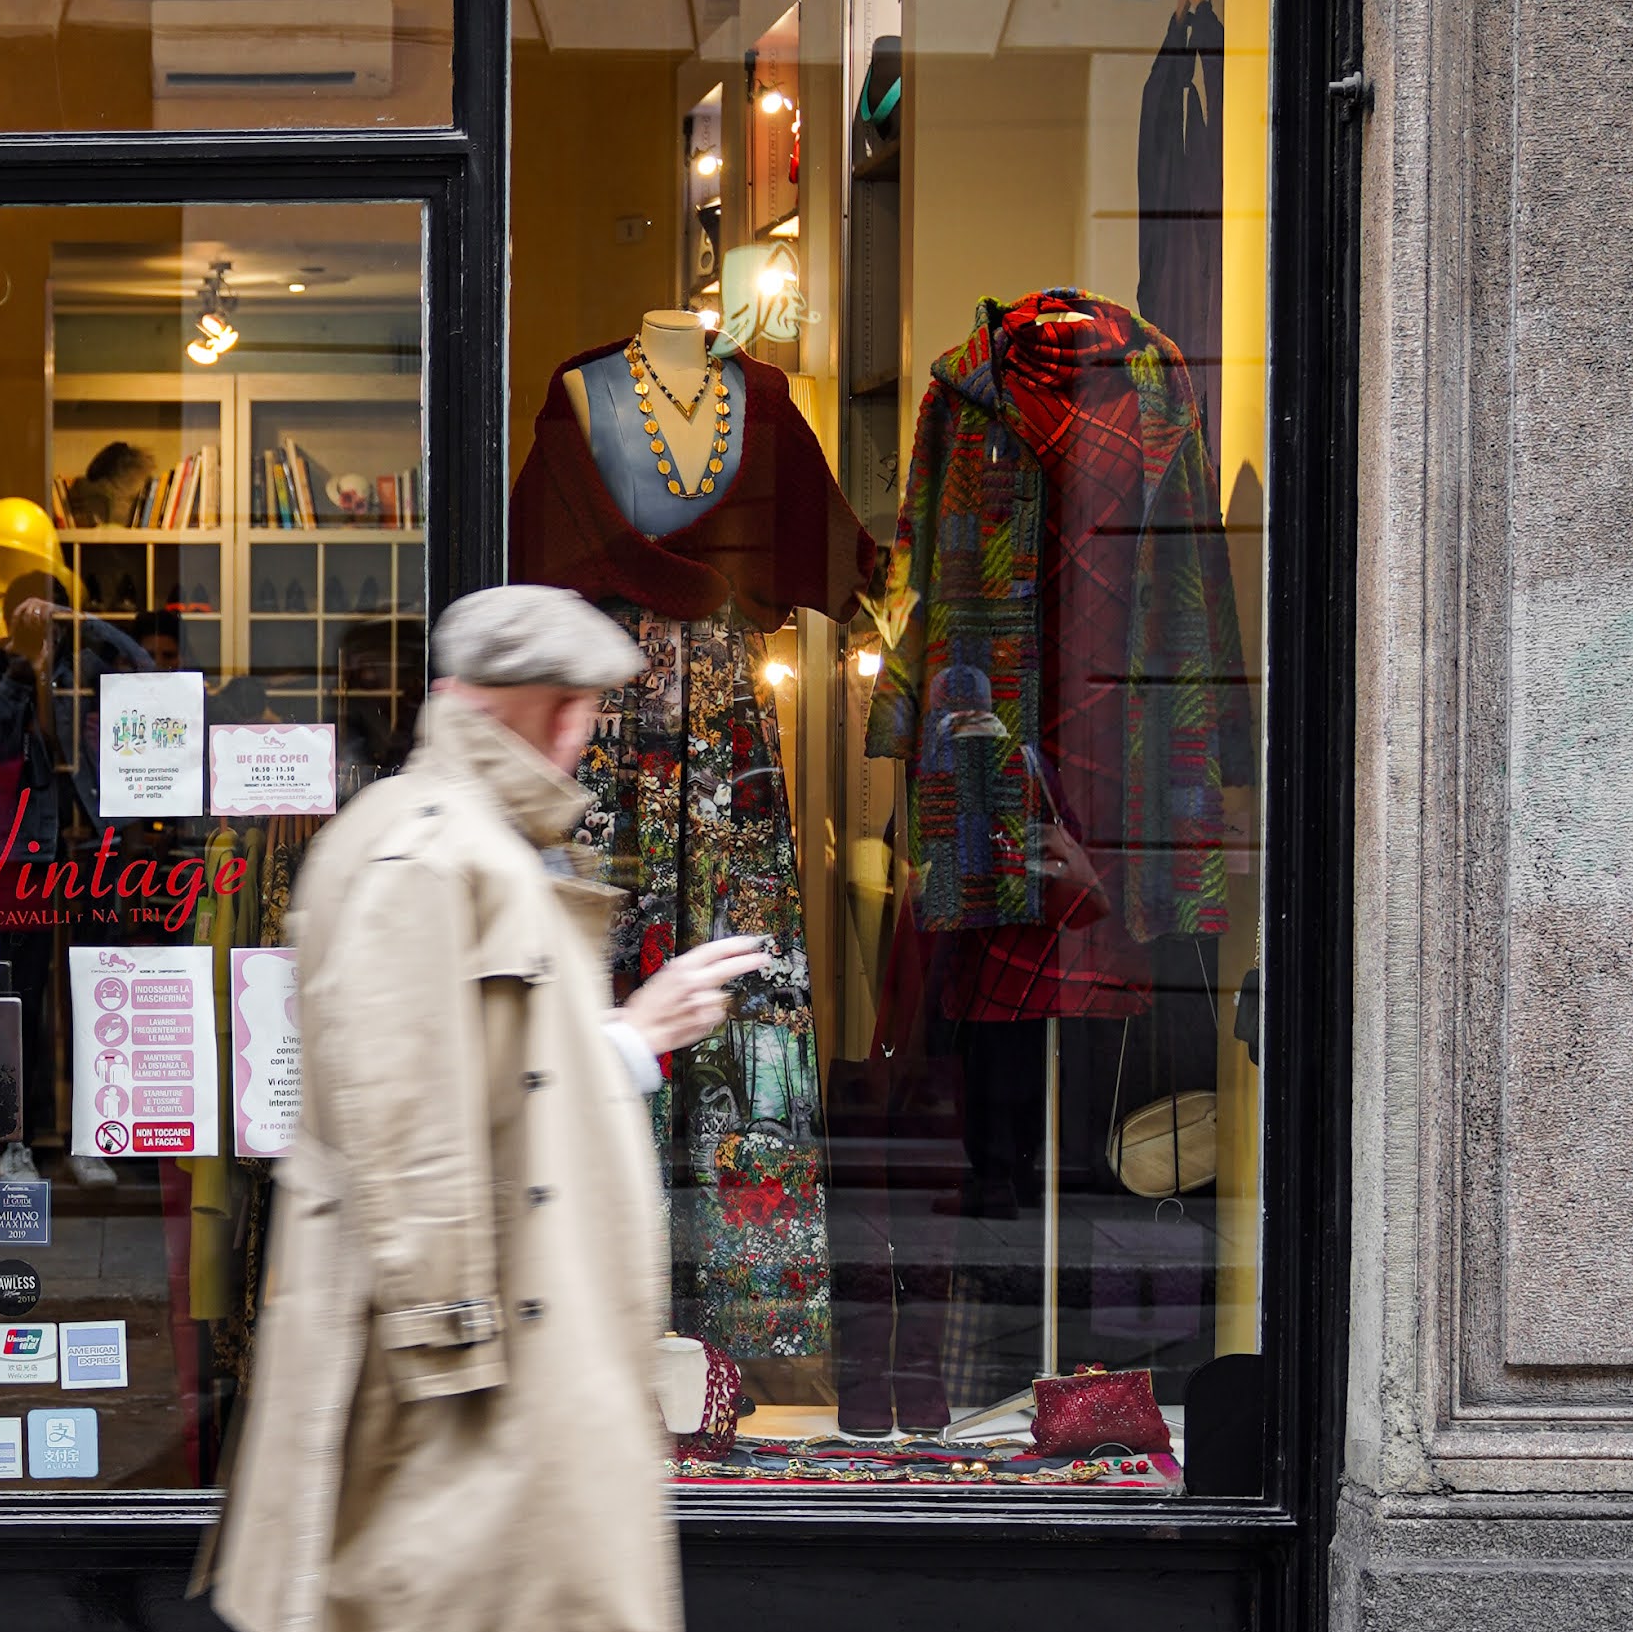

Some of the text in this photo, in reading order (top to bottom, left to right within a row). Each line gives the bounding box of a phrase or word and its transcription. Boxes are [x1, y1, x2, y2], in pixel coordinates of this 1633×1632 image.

[237, 754, 308, 763] WE ARE OPEN
[134, 985, 190, 993] INDOSSARE LA
[136, 994, 188, 1003] MASCHERINA.
[149, 1018, 176, 1026] LAVARSI
[134, 1026, 192, 1034] FREQUENTEMENTE
[148, 1034, 158, 1042] LE
[283, 1036, 301, 1045] L'ing
[287, 1067, 303, 1075] indo
[268, 1078, 303, 1086] Vi ricord
[152, 1097, 180, 1105] TOSSIRE
[143, 1105, 155, 1113] NEL
[136, 1128, 190, 1137] NON TOCCARSI
[143, 1138, 184, 1146] LA FACCIA.
[8, 1230, 26, 1238] 2019
[7, 1335, 40, 1343] UnionPay
[68, 1346, 116, 1355] AMERICAN
[79, 1356, 120, 1365] EXPRESS
